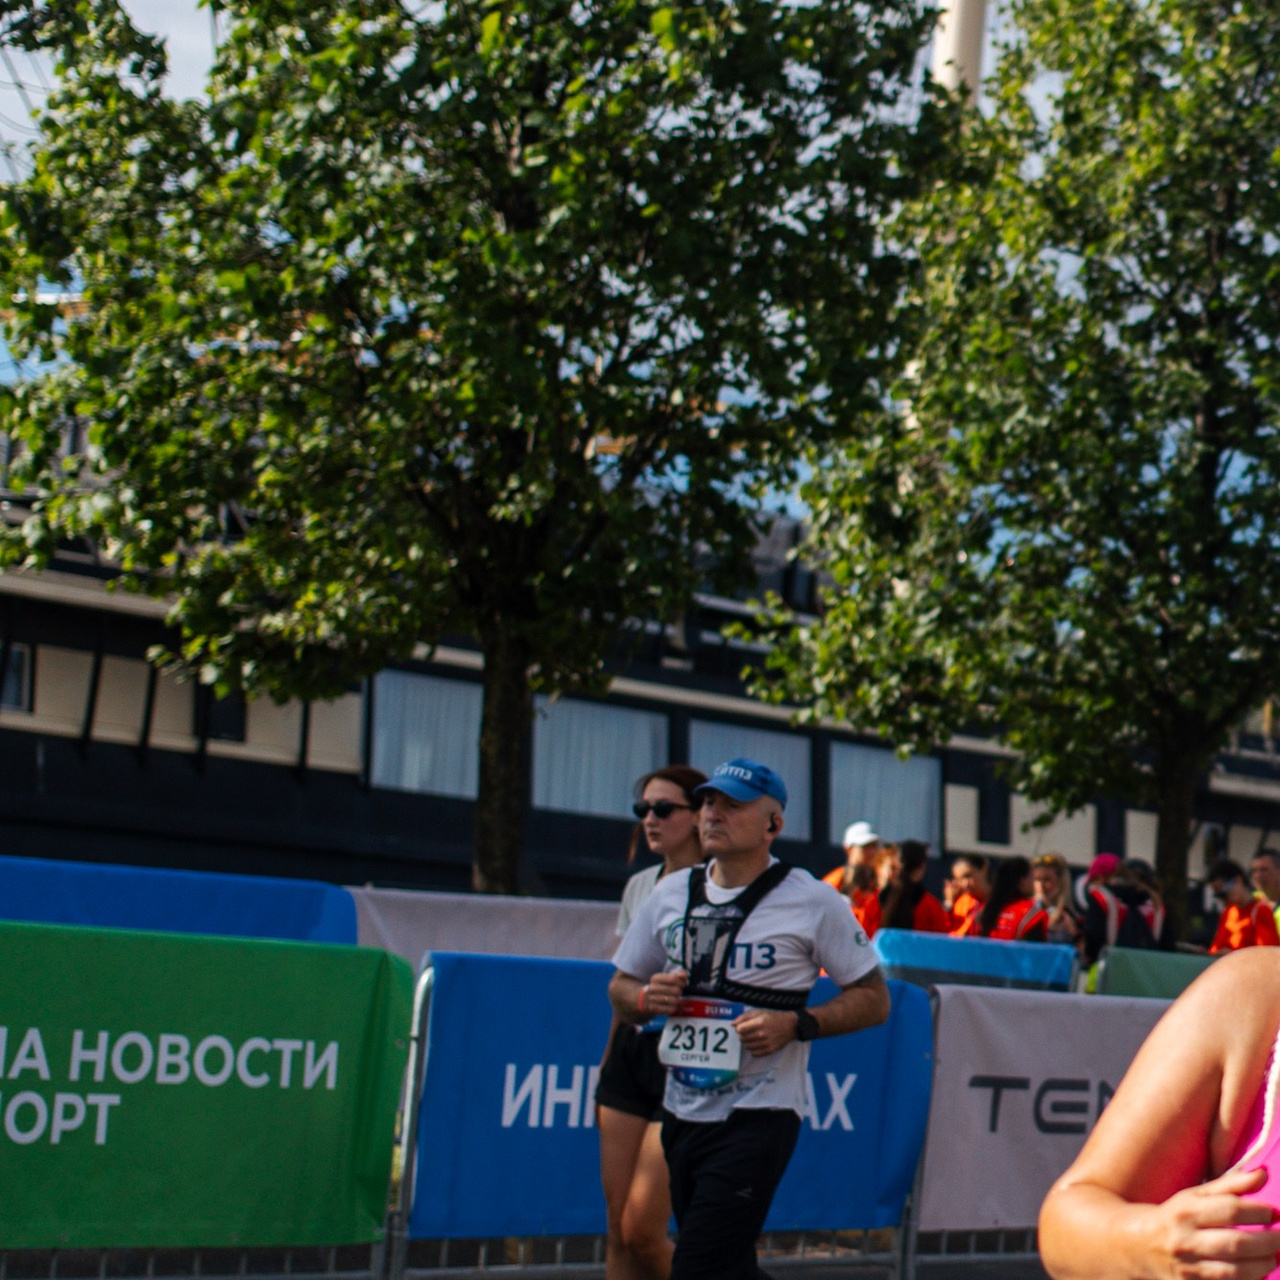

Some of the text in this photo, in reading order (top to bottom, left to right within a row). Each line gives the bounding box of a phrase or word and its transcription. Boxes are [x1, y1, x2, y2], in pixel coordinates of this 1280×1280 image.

[69, 1029, 339, 1090] НОВОСТИ
[668, 1024, 729, 1053] 2312
[0, 1089, 121, 1146] ОРТ
